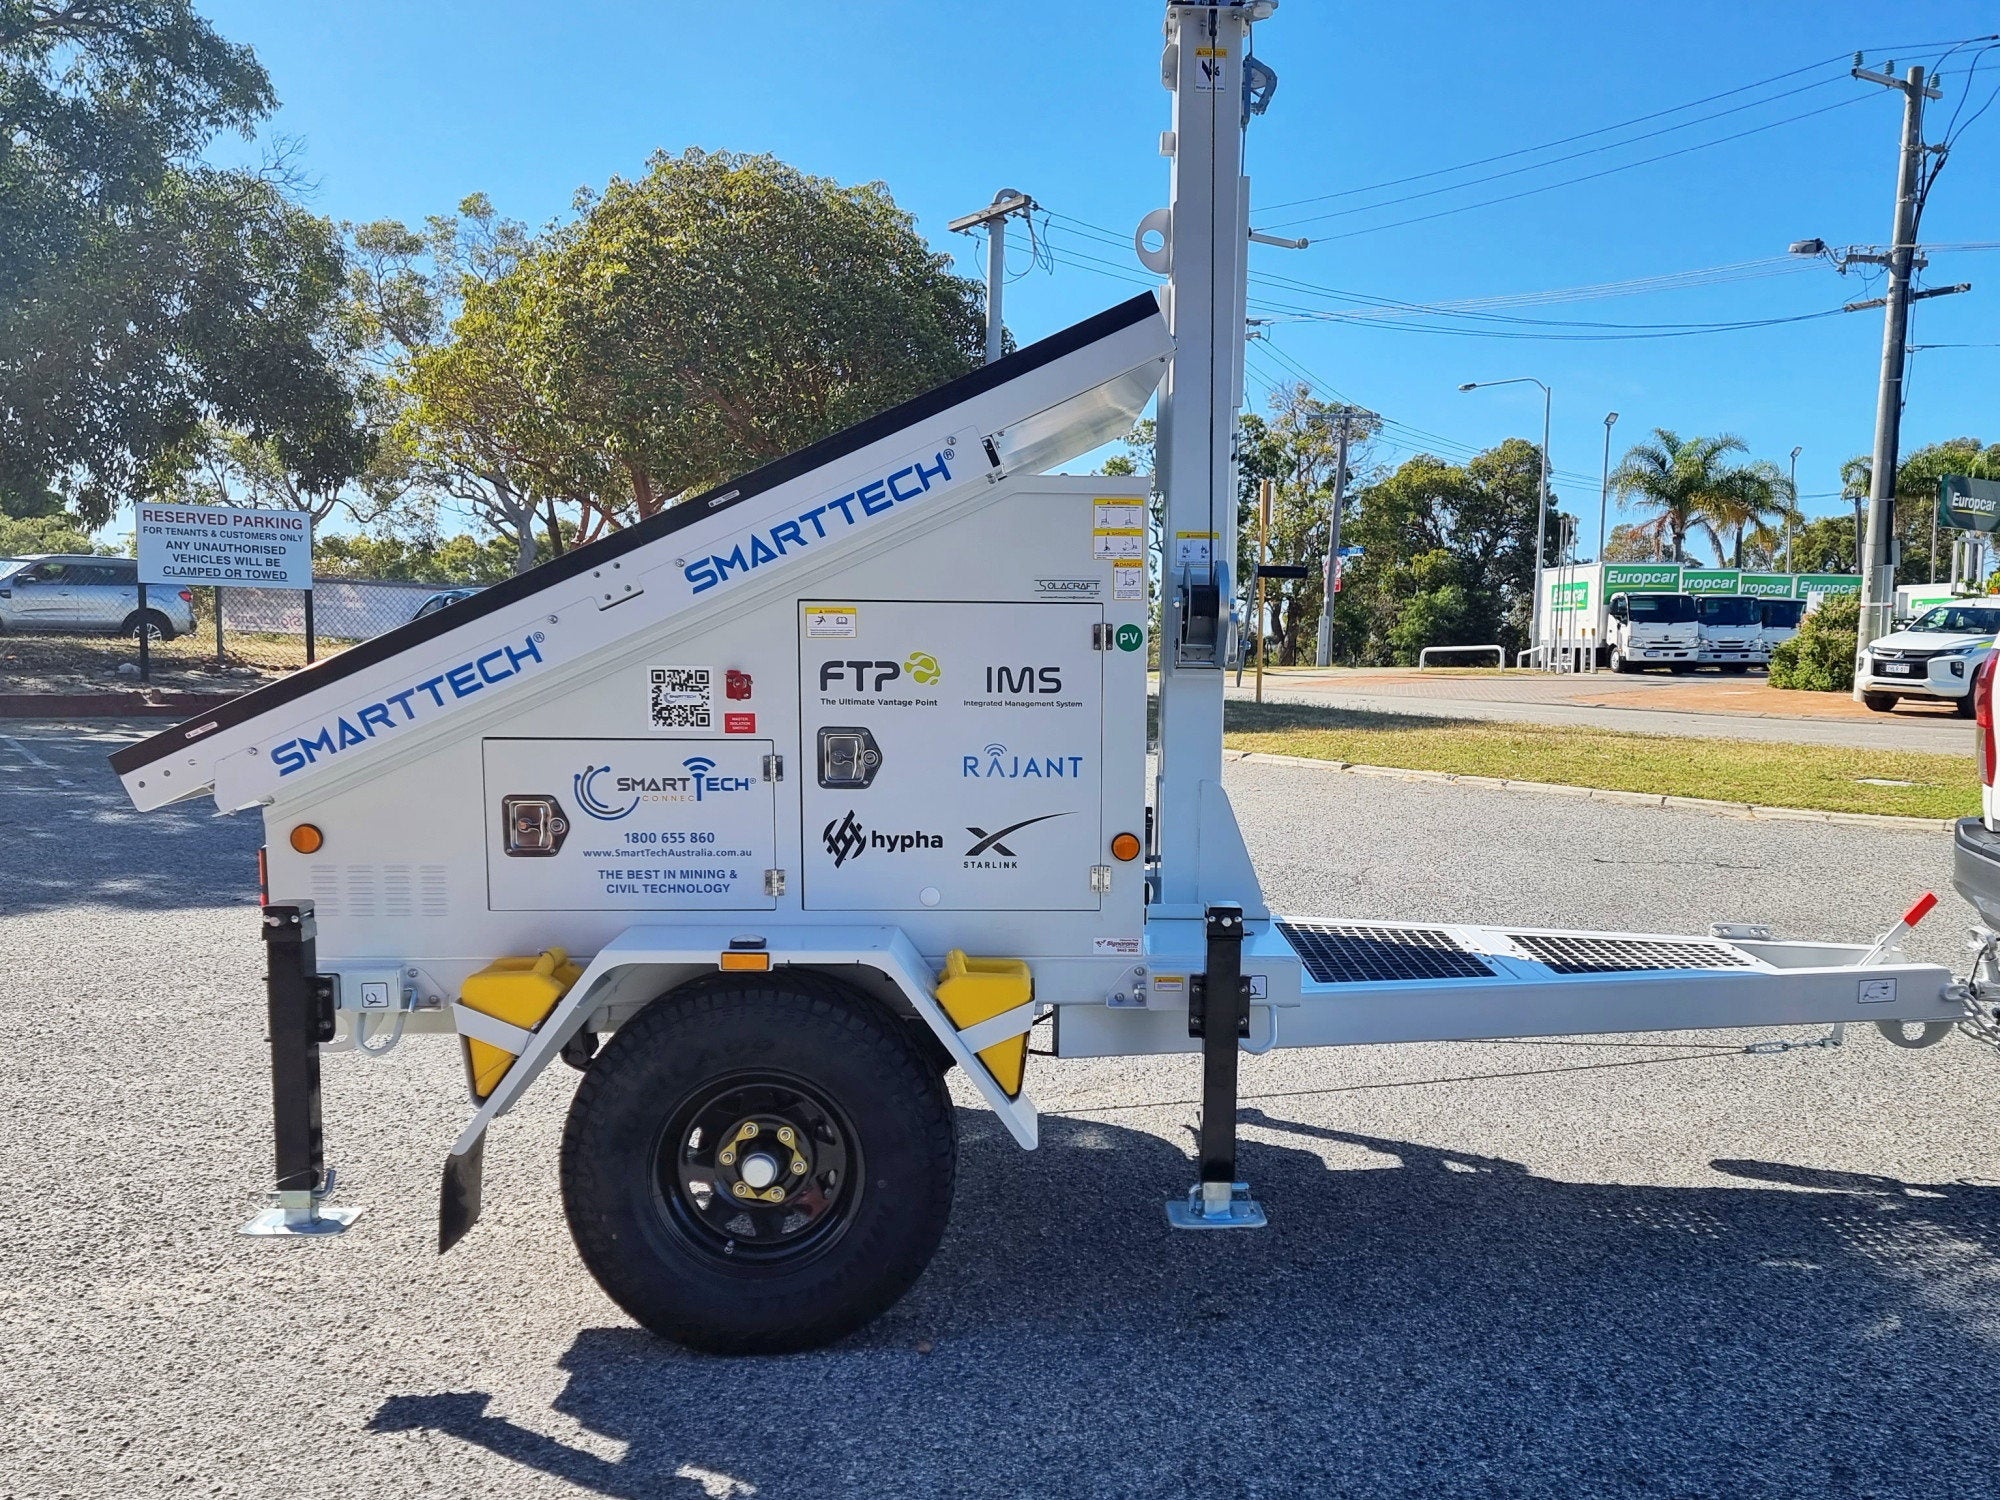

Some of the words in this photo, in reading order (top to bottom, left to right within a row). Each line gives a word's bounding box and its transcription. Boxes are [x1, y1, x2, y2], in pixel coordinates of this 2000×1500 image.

[1952, 492, 1997, 512] Europcar
[142, 510, 228, 526] RESERVED
[233, 514, 303, 530] PARKING
[143, 526, 163, 535] FOR
[165, 528, 208, 538] TENANTS
[211, 529, 218, 538] &
[220, 530, 277, 541] CUSTOMERS
[280, 534, 304, 542] ONLY
[165, 541, 191, 551] ANY
[193, 542, 286, 555] UNAUTHORISED
[172, 553, 231, 565] VEHICLES
[234, 556, 263, 567] WILL
[266, 558, 281, 567] BE
[163, 566, 222, 577] CLAMPED
[224, 568, 242, 578] OR
[245, 570, 288, 580] TOWED
[1607, 570, 1678, 587] Europcar
[1682, 577, 1737, 593] uropcar
[1741, 582, 1790, 597] ropcar
[1119, 632, 1139, 644] PV
[820, 660, 900, 692] FTP
[986, 666, 1062, 694] IMS
[820, 698, 836, 706] The
[838, 698, 875, 706] Ultimate
[878, 699, 913, 708] Vantage
[963, 700, 1002, 708] Integrated
[1005, 700, 1054, 708] Management
[1056, 701, 1083, 709] System
[963, 756, 1083, 778] RAJANT
[624, 832, 656, 844] 1800
[660, 832, 686, 844] 655
[690, 832, 715, 844] 860
[871, 830, 944, 853] hypha
[583, 848, 752, 858] www.SmartTechAustralia.com.au
[963, 861, 1018, 869] STARLINK
[598, 870, 623, 880] THE
[627, 870, 660, 880] BEST
[664, 870, 676, 880] IN
[679, 870, 726, 880] MINING
[729, 870, 738, 880] &
[606, 884, 639, 894] CIVIL
[642, 883, 731, 894] TECHNOLOGY
